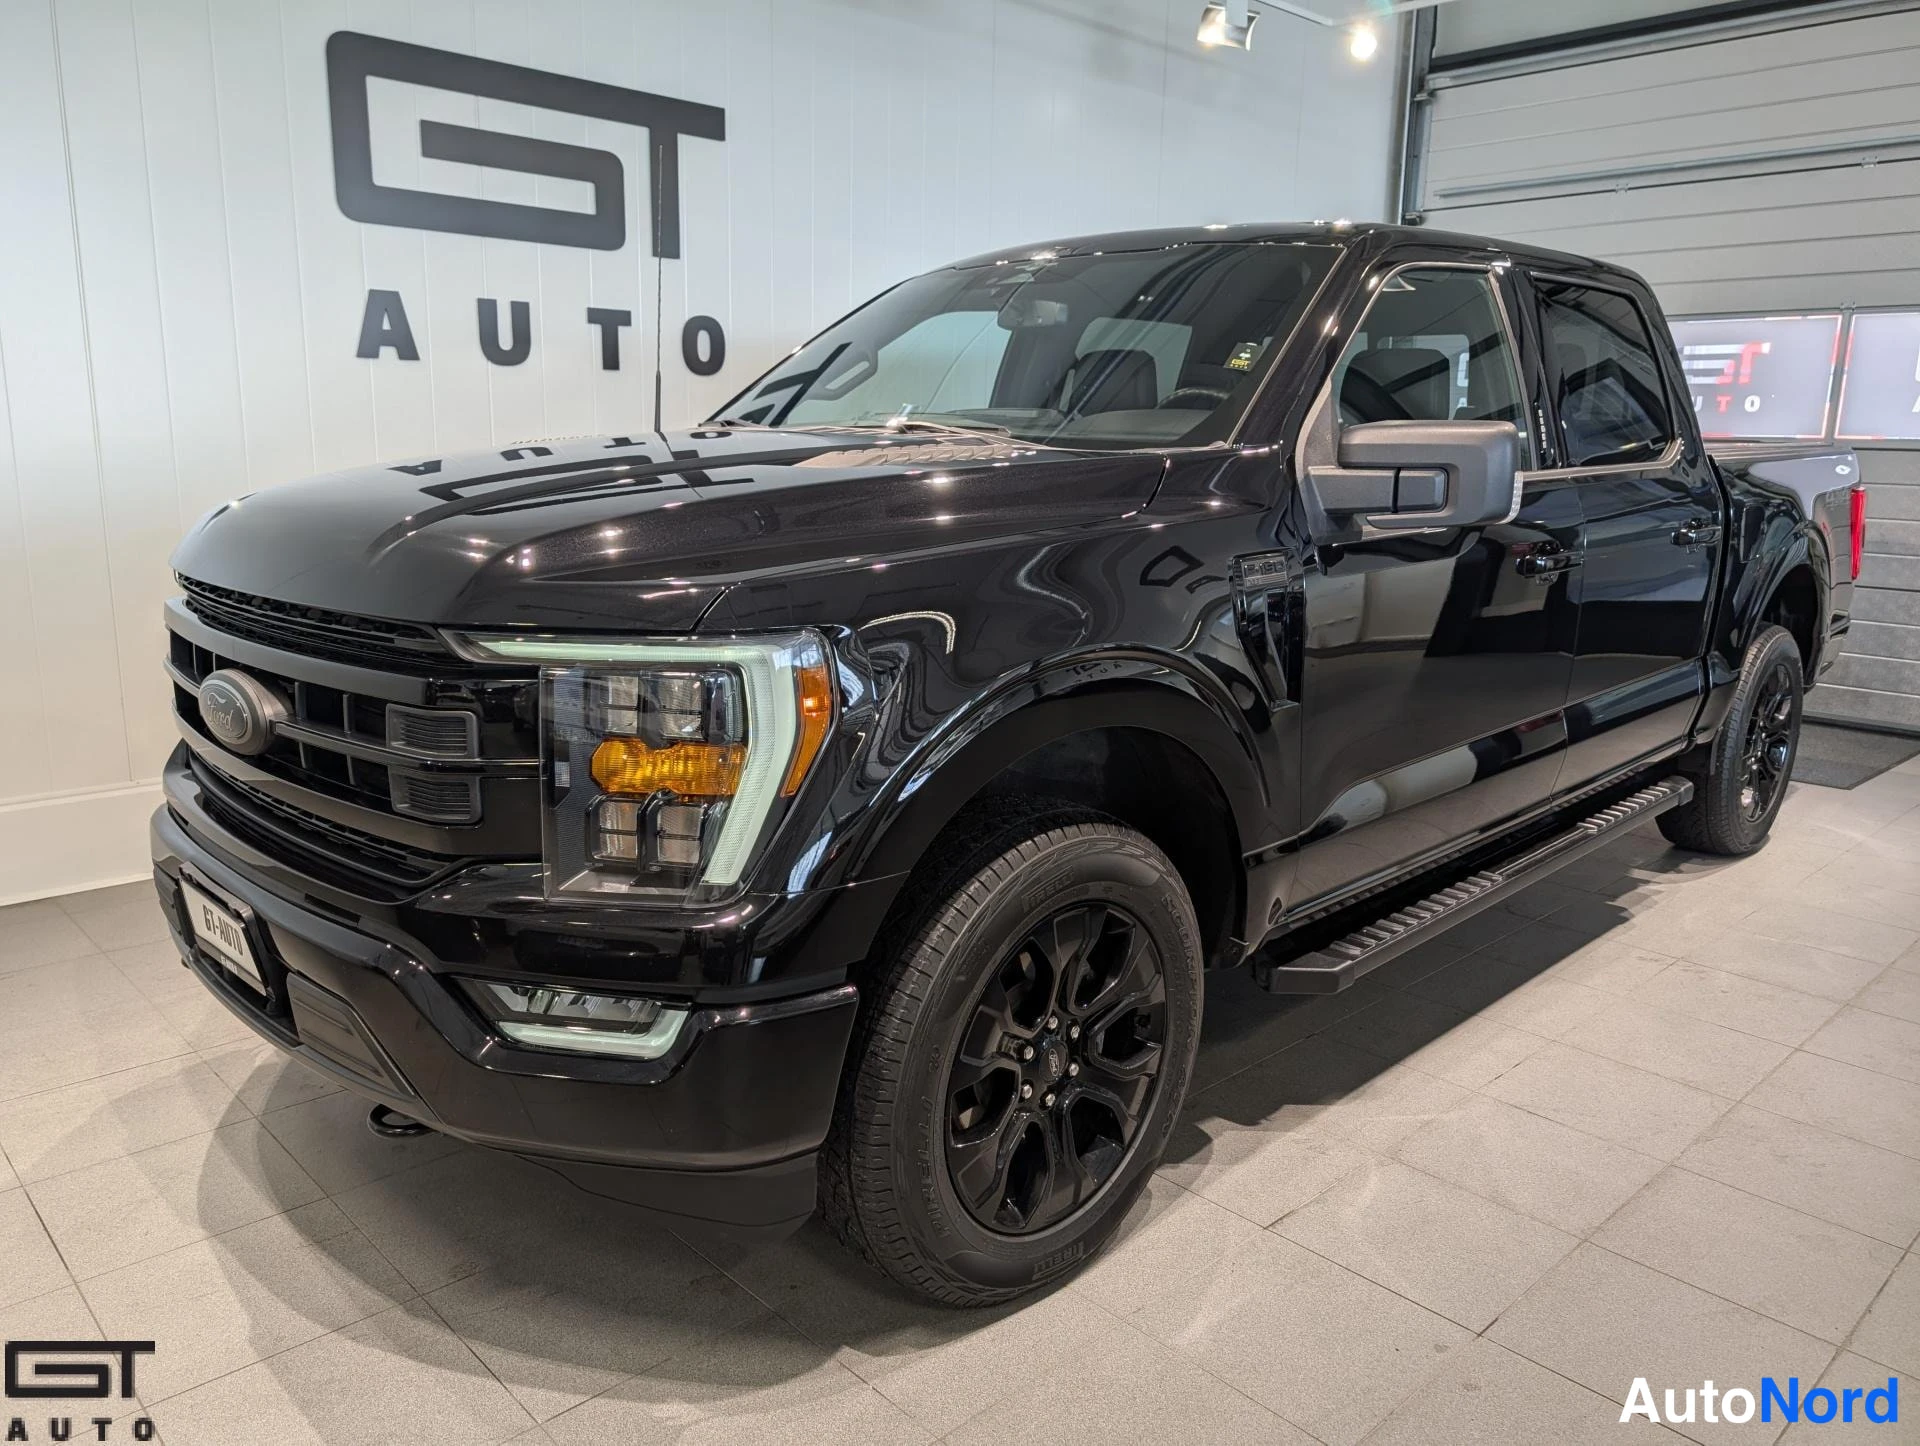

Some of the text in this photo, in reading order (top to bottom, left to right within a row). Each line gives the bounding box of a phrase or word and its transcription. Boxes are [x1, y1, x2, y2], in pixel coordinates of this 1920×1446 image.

[326, 30, 725, 259] GT
[356, 289, 725, 376] AUTO
[1690, 394, 1762, 414] UTO
[207, 692, 234, 731] Ford
[202, 903, 244, 956] GT-AUTO
